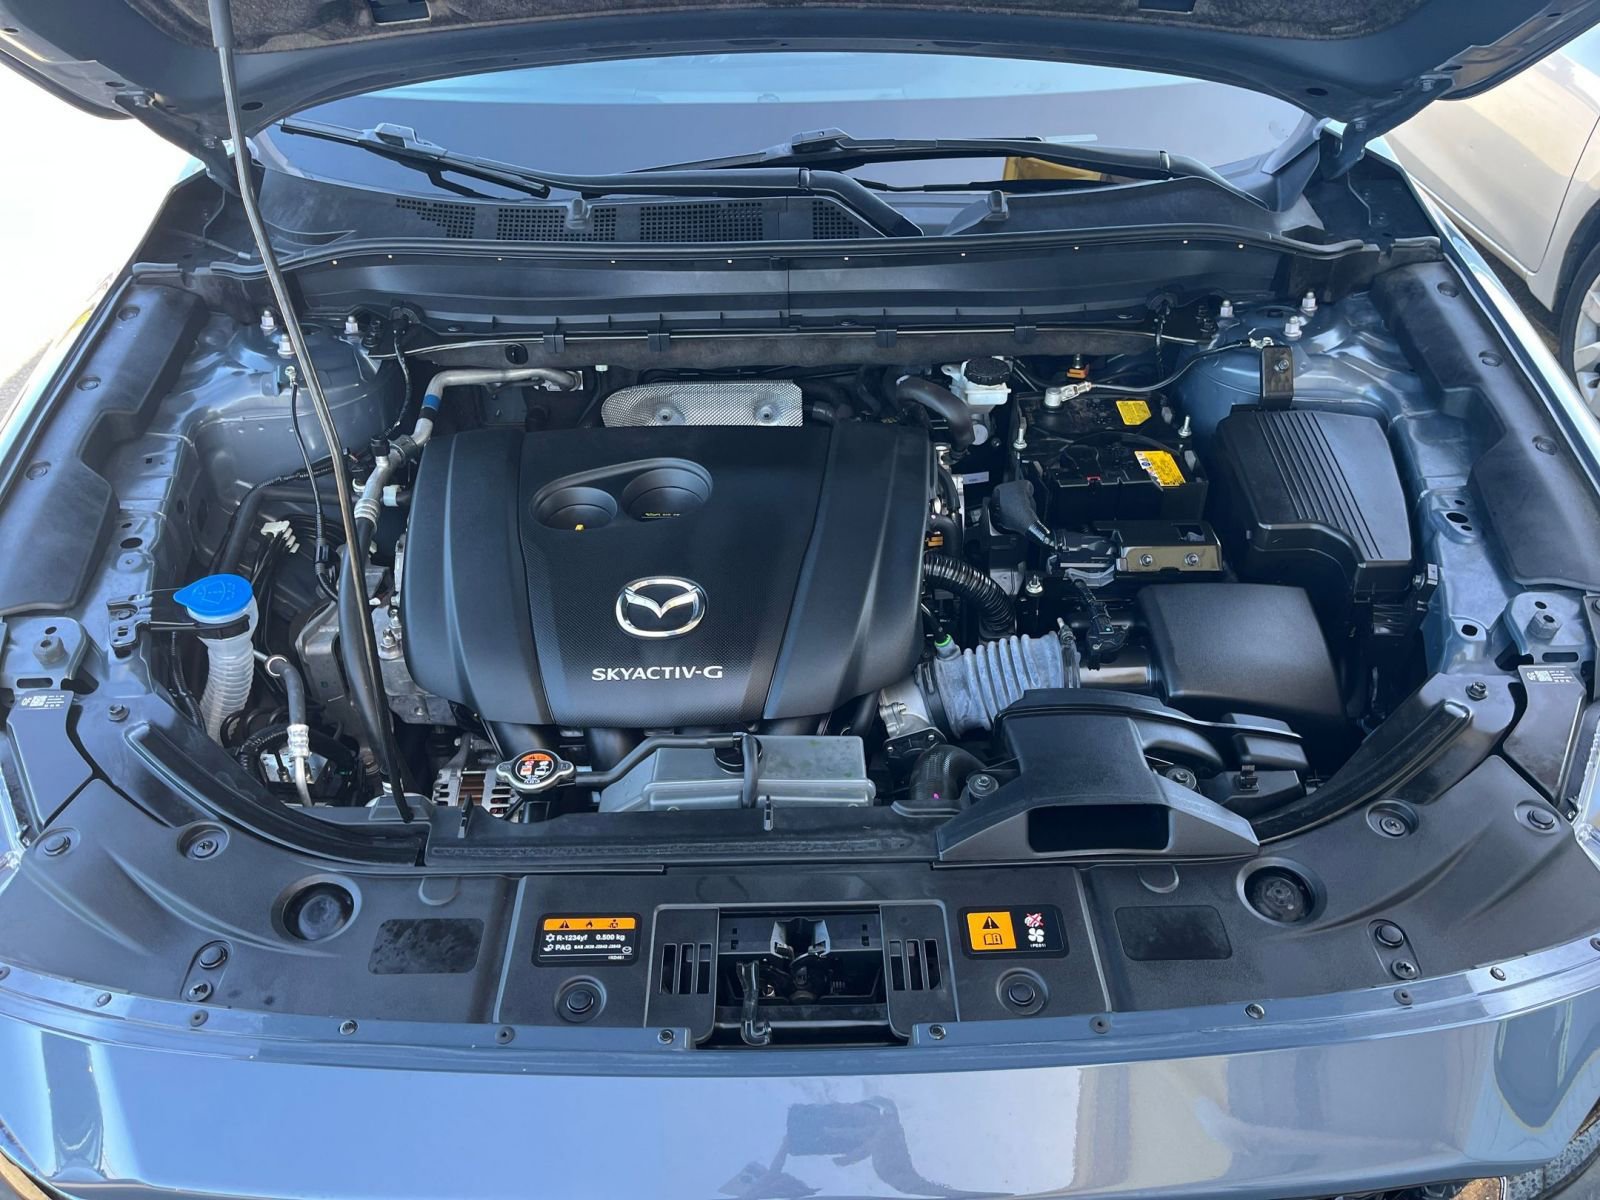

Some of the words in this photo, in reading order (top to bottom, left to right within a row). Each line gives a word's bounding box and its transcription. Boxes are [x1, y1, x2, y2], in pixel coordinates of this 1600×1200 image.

[591, 665, 723, 681] SKYACTIV-G
[556, 934, 588, 942] R-1234yf
[616, 933, 626, 942] kg
